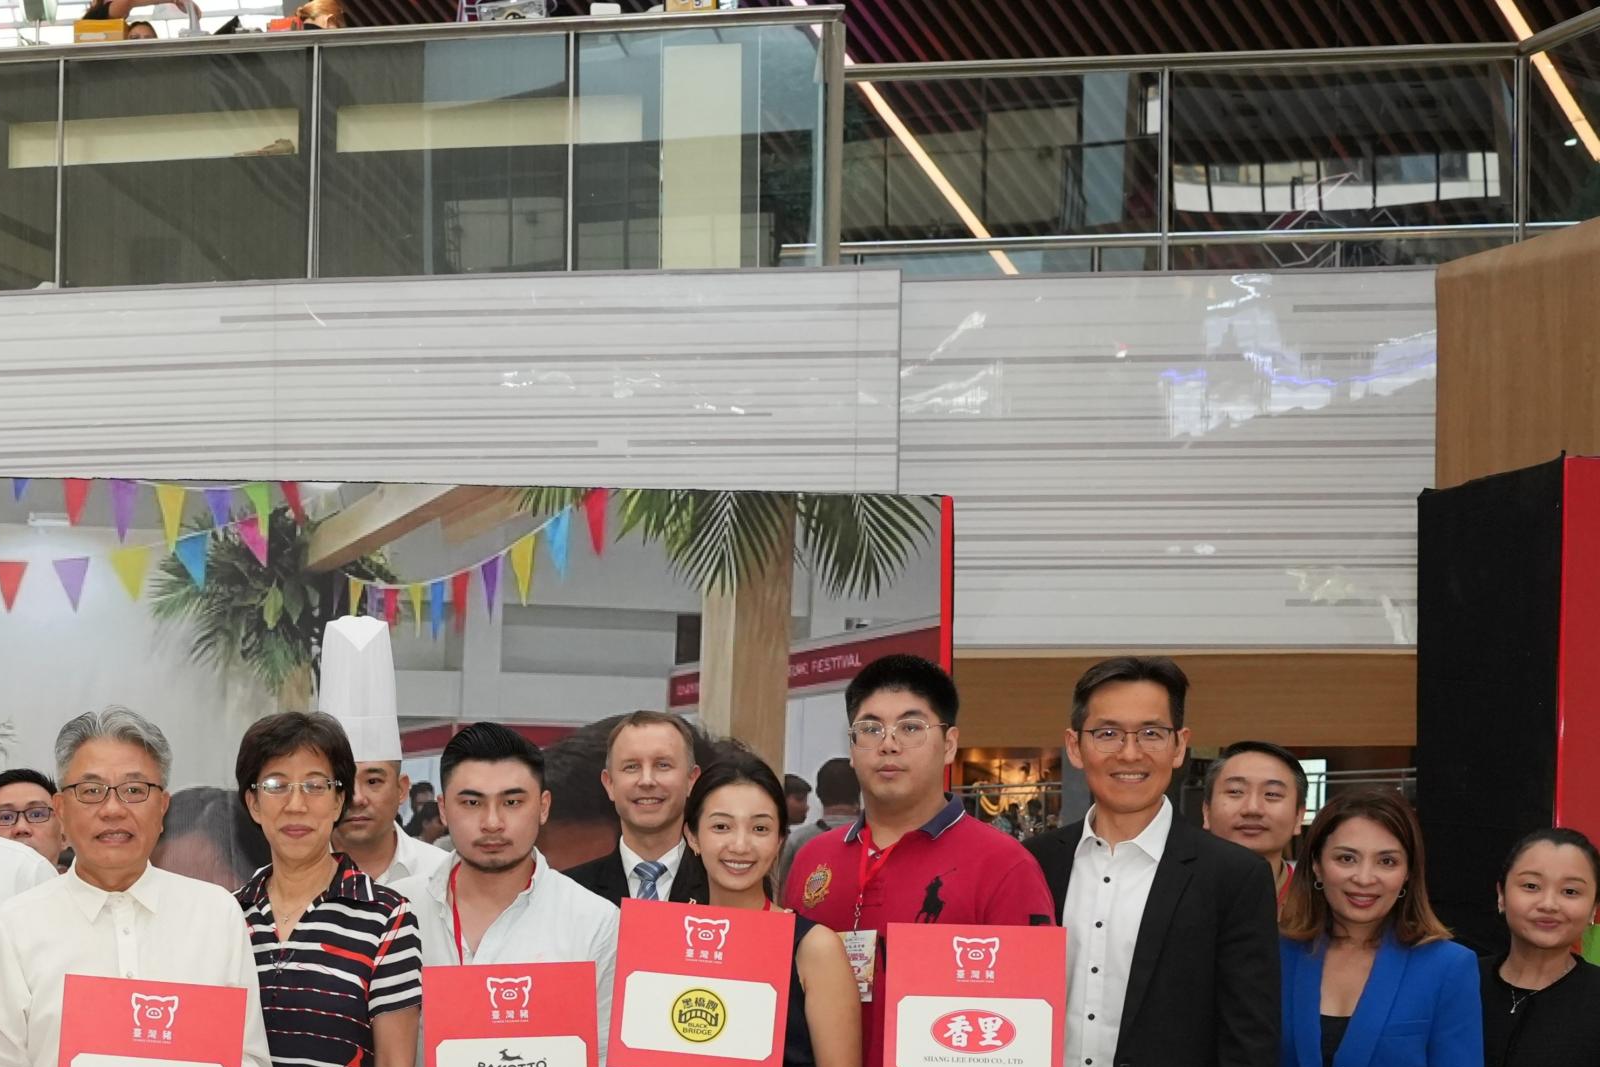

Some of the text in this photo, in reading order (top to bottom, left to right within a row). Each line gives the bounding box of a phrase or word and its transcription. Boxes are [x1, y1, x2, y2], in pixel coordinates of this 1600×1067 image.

[811, 653, 862, 673] FESTIVAL
[682, 1027, 712, 1036] BRIDGE
[943, 1015, 1004, 1047] 香里
